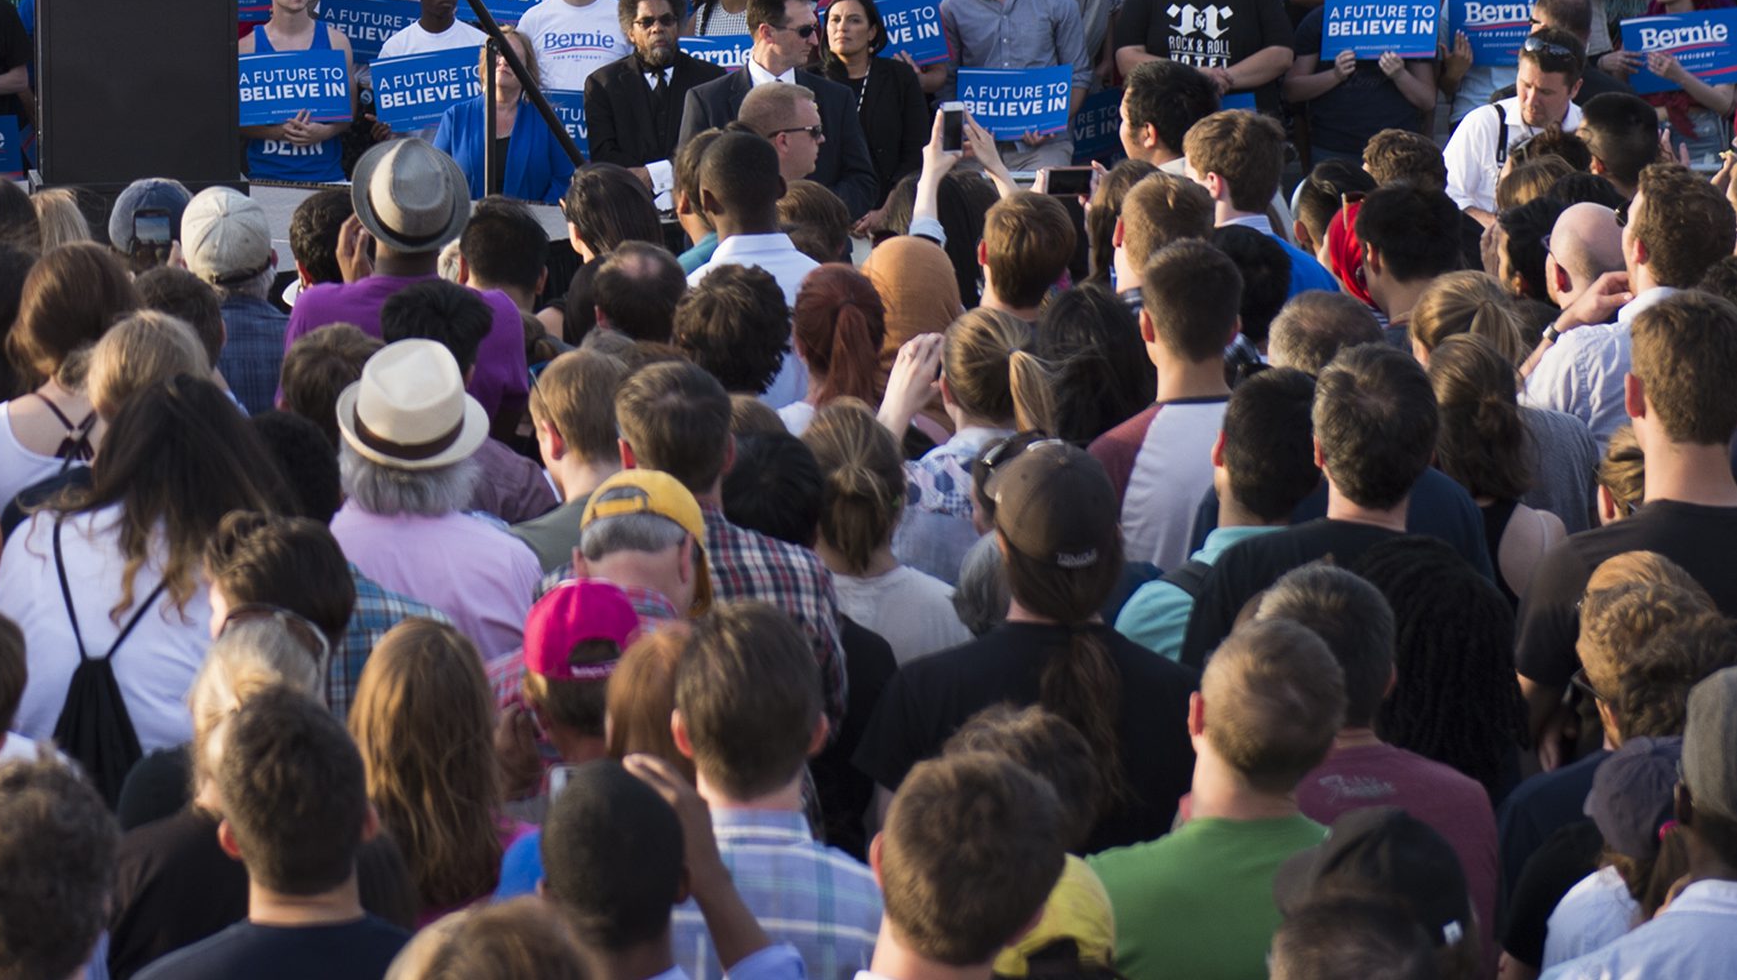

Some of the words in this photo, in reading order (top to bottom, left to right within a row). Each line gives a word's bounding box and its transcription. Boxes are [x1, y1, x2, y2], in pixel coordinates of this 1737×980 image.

[325, 8, 335, 20] A
[340, 10, 402, 27] FUTURE
[913, 6, 936, 20] TO
[1330, 7, 1341, 20] A
[1345, 6, 1409, 19] FUTURE
[1413, 6, 1436, 18] TO
[916, 20, 939, 39] IN
[1329, 20, 1407, 36] BELIEVE
[1413, 19, 1435, 35] IN
[544, 32, 614, 49] Bernie
[1168, 35, 1193, 50] ROCK
[1196, 39, 1205, 49] &
[1208, 40, 1230, 55] ROLL
[1639, 23, 1728, 52] Bernie
[239, 72, 249, 84] A
[254, 68, 316, 82] FUTURE
[320, 67, 344, 80] TO
[379, 77, 391, 89] A
[394, 70, 458, 88] FUTURE
[240, 84, 319, 100] BELIEVE
[325, 82, 346, 97] IN
[381, 88, 460, 108] BELIEVE
[964, 86, 975, 99] A
[978, 83, 1043, 99] FUTURE
[1047, 81, 1068, 95] TO
[964, 100, 1044, 117] BELIEVE
[1048, 95, 1067, 112] IN
